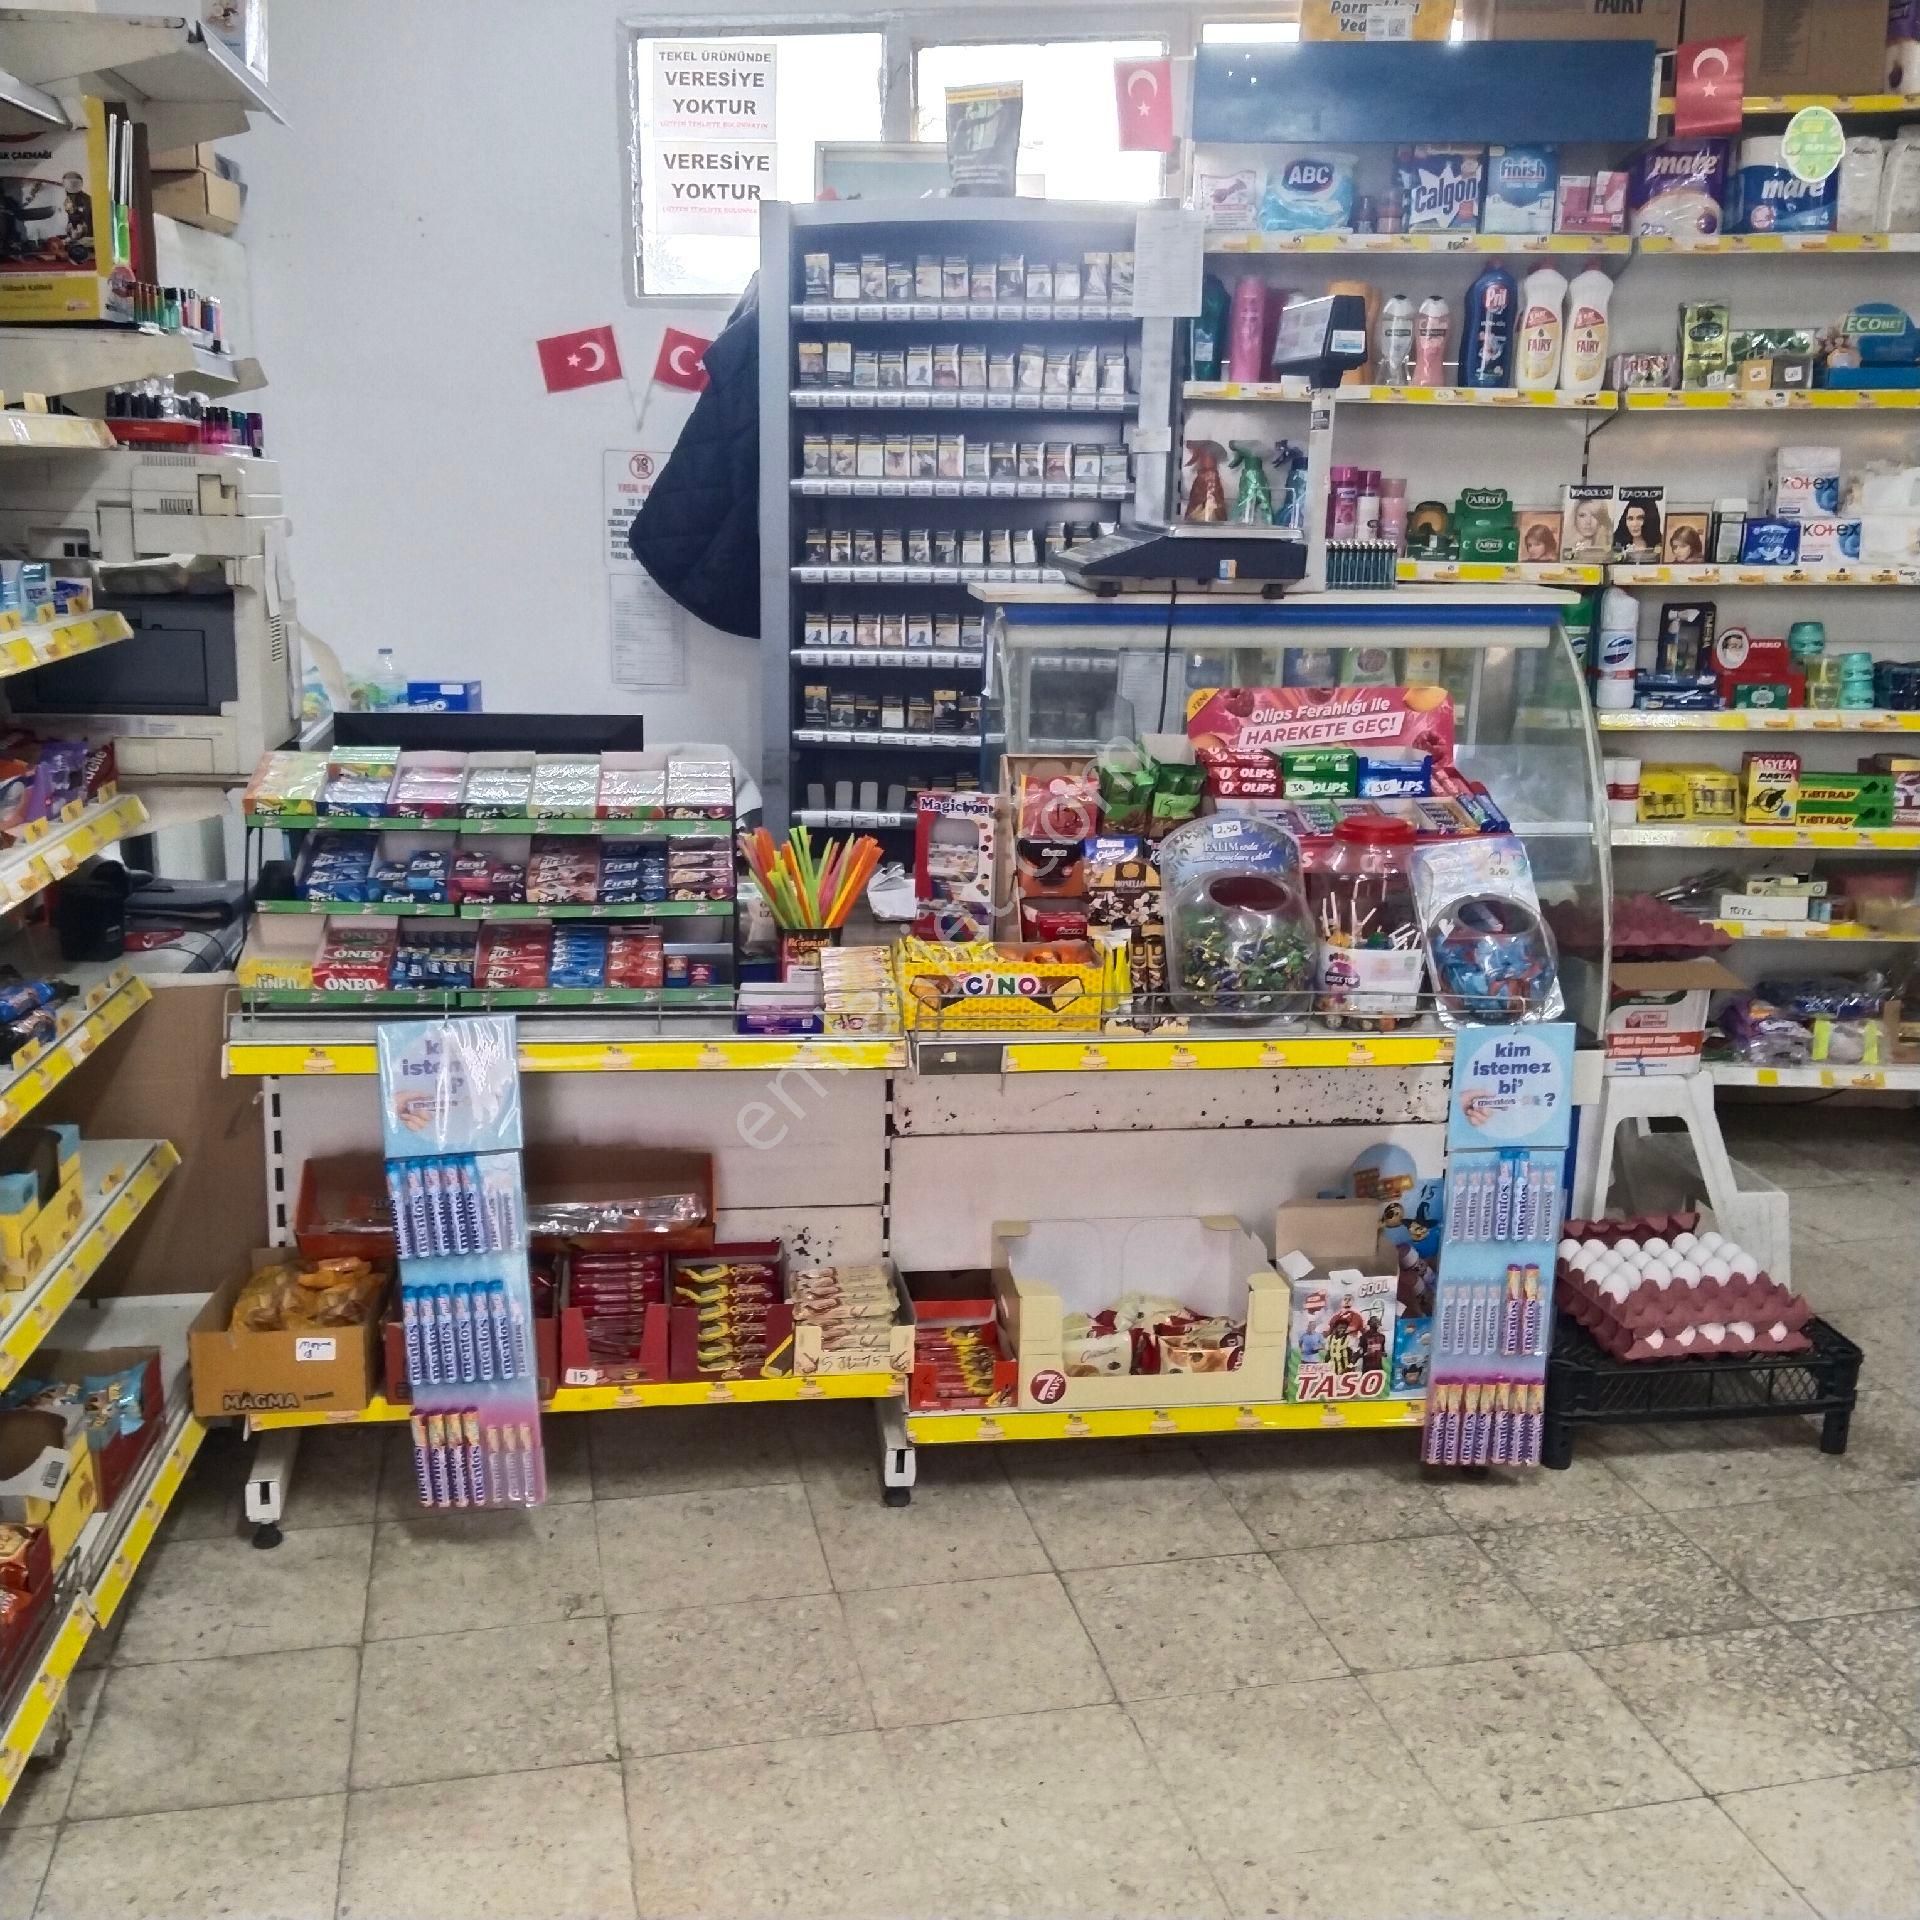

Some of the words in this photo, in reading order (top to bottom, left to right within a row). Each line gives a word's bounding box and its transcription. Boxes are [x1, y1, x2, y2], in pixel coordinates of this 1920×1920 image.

[658, 51, 697, 62] TEKEL
[701, 50, 772, 63] ÜRÜNÜNDE
[664, 69, 765, 88] VERESİYE
[672, 99, 757, 115] YOKTUR
[663, 152, 770, 171] VERESİYE
[1500, 157, 1546, 180] finish
[1287, 165, 1330, 186] ABC
[671, 183, 762, 200] YOKTUR
[1413, 177, 1479, 217] Calgon
[1762, 176, 1826, 200] mare
[1527, 338, 1552, 352] FAIRY
[1576, 340, 1600, 353] FAIRY
[1467, 492, 1502, 507] ARKO
[1478, 540, 1502, 550] ARKO
[1251, 706, 1294, 723] Olips
[1244, 722, 1347, 746] HAREKETE
[1351, 715, 1396, 736] GEÇ!
[1494, 1042, 1532, 1057] kim
[1472, 1060, 1552, 1076] istemez
[1544, 1091, 1557, 1107] ?
[1495, 1183, 1511, 1237] mentos
[1516, 1183, 1530, 1237] mentos
[1524, 1299, 1536, 1351] mentos
[408, 1324, 422, 1382] mentos
[441, 1320, 455, 1380] mentos
[460, 1319, 474, 1378] mentos
[478, 1317, 492, 1376] mentos
[498, 1316, 514, 1375] mentos
[572, 1371, 588, 1383] 15
[1035, 1374, 1057, 1401] 7
[1297, 1372, 1385, 1401] TASO
[223, 1392, 300, 1411] MAGMA
[470, 1445, 485, 1501] mentos
